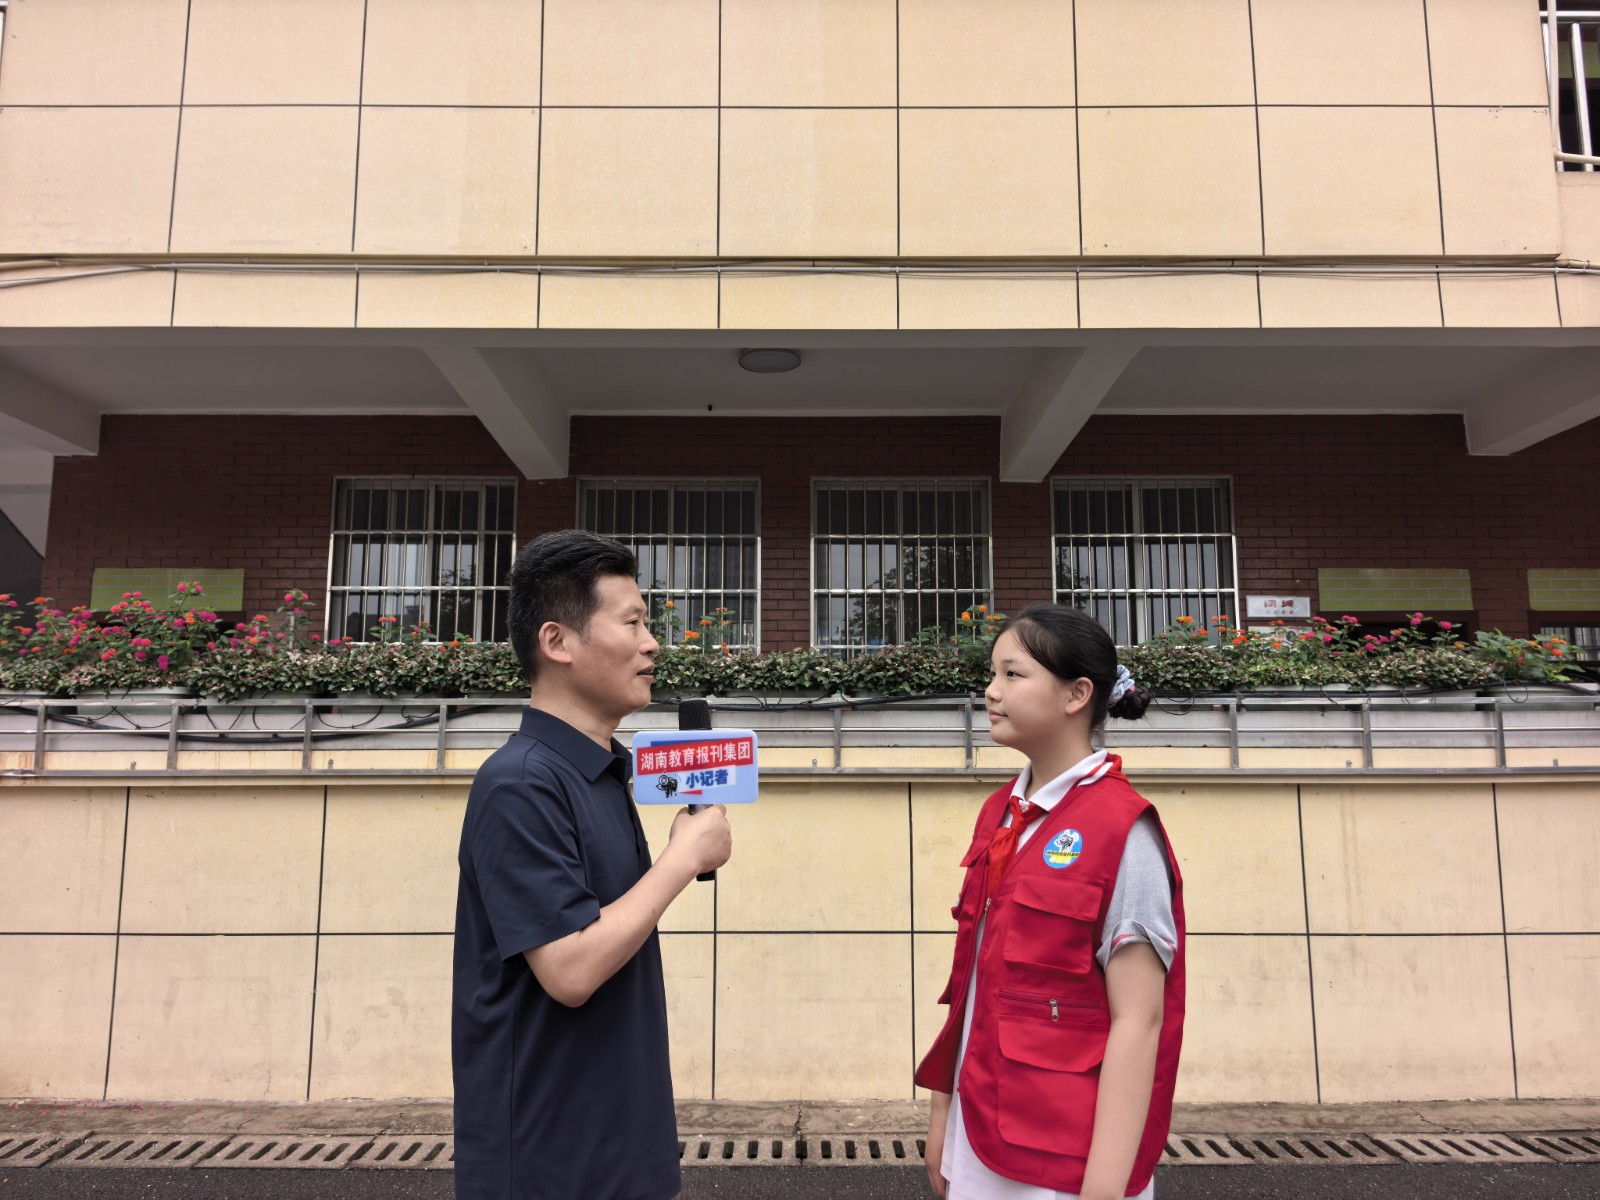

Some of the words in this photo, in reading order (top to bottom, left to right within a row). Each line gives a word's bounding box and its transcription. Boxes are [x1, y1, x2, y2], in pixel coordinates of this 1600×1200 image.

[641, 741, 750, 770] 湖南教育报刊集团
[686, 769, 728, 788] 小记者
